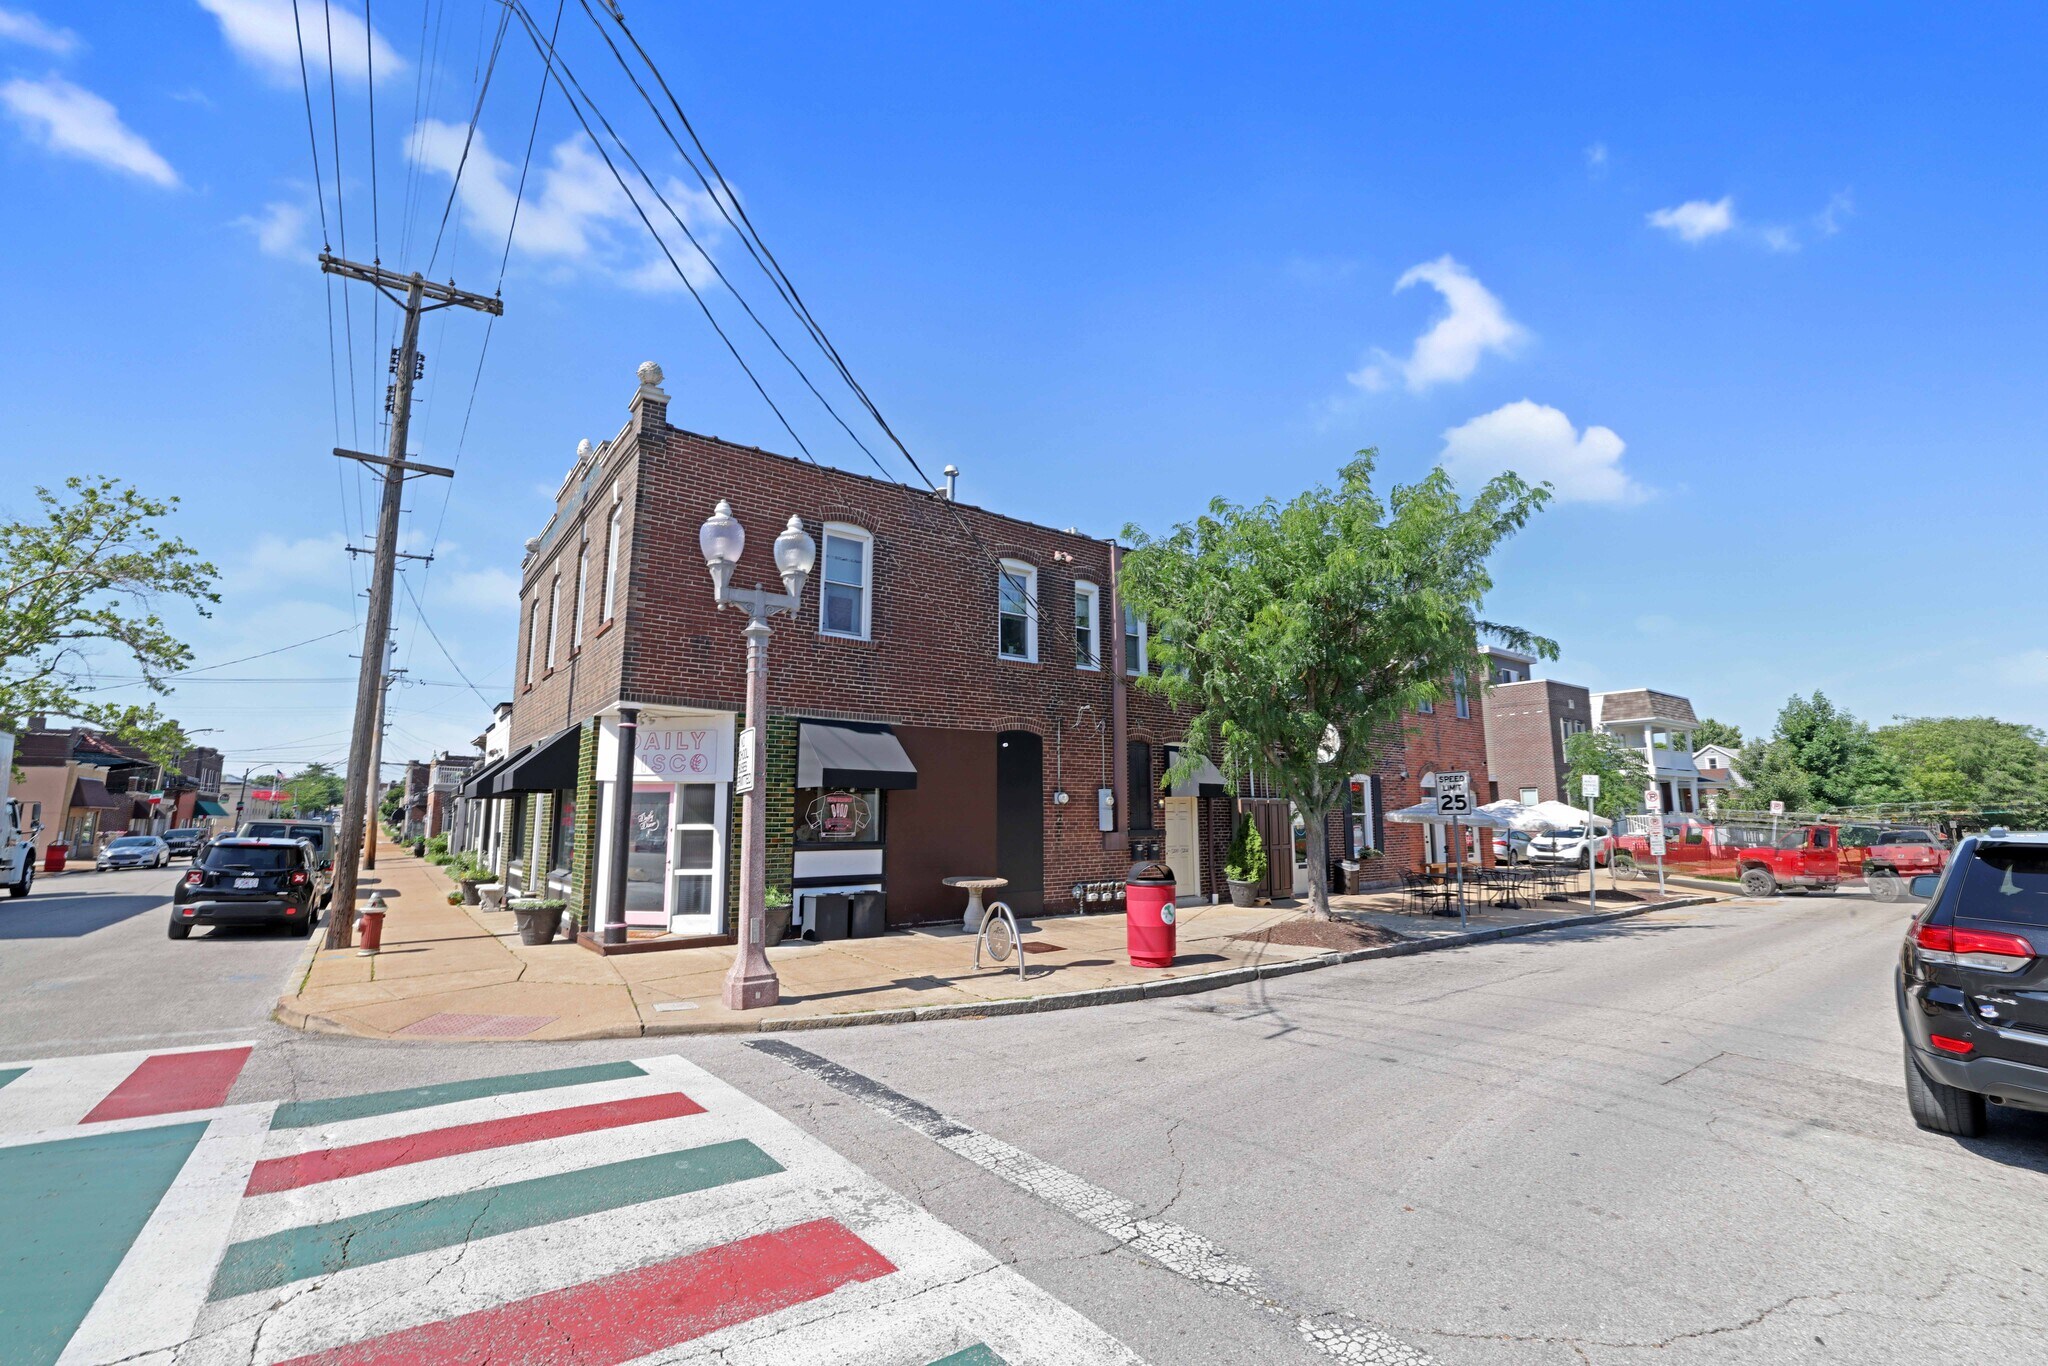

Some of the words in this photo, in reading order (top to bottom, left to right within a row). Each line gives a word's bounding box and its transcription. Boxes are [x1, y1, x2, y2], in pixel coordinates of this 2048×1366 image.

[634, 753, 708, 774] ISCO
[1439, 775, 1465, 783] SPEED
[1441, 794, 1467, 811] 25
